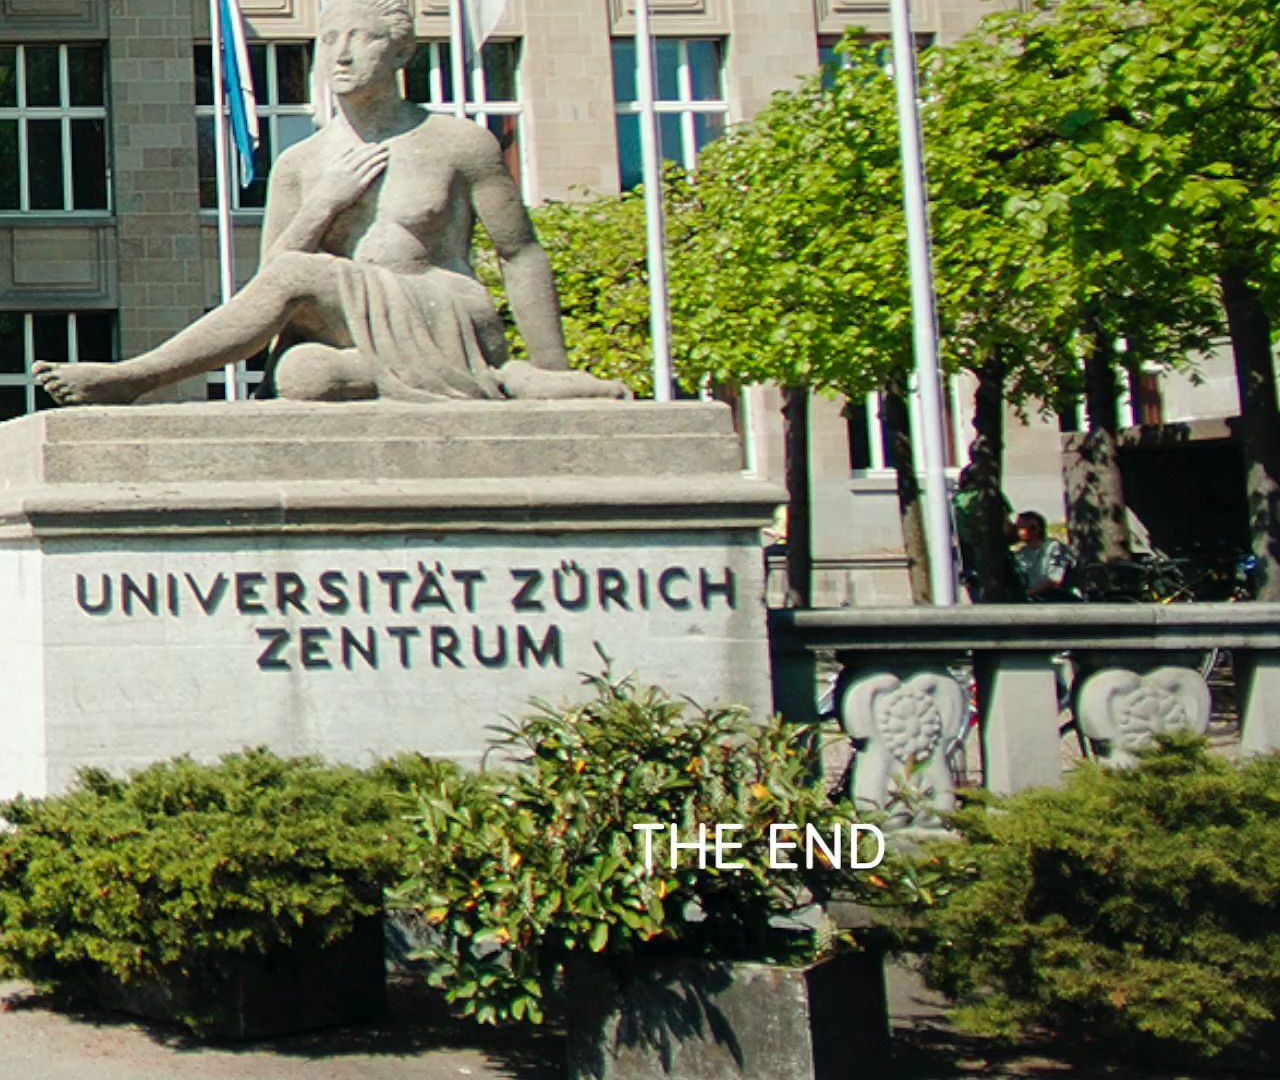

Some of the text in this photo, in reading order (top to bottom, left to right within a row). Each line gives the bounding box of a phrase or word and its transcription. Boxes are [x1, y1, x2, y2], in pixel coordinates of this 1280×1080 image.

[75, 560, 738, 617] UNIVERSITÄT ZÜRICH
[256, 624, 566, 671] ZENTRUM
